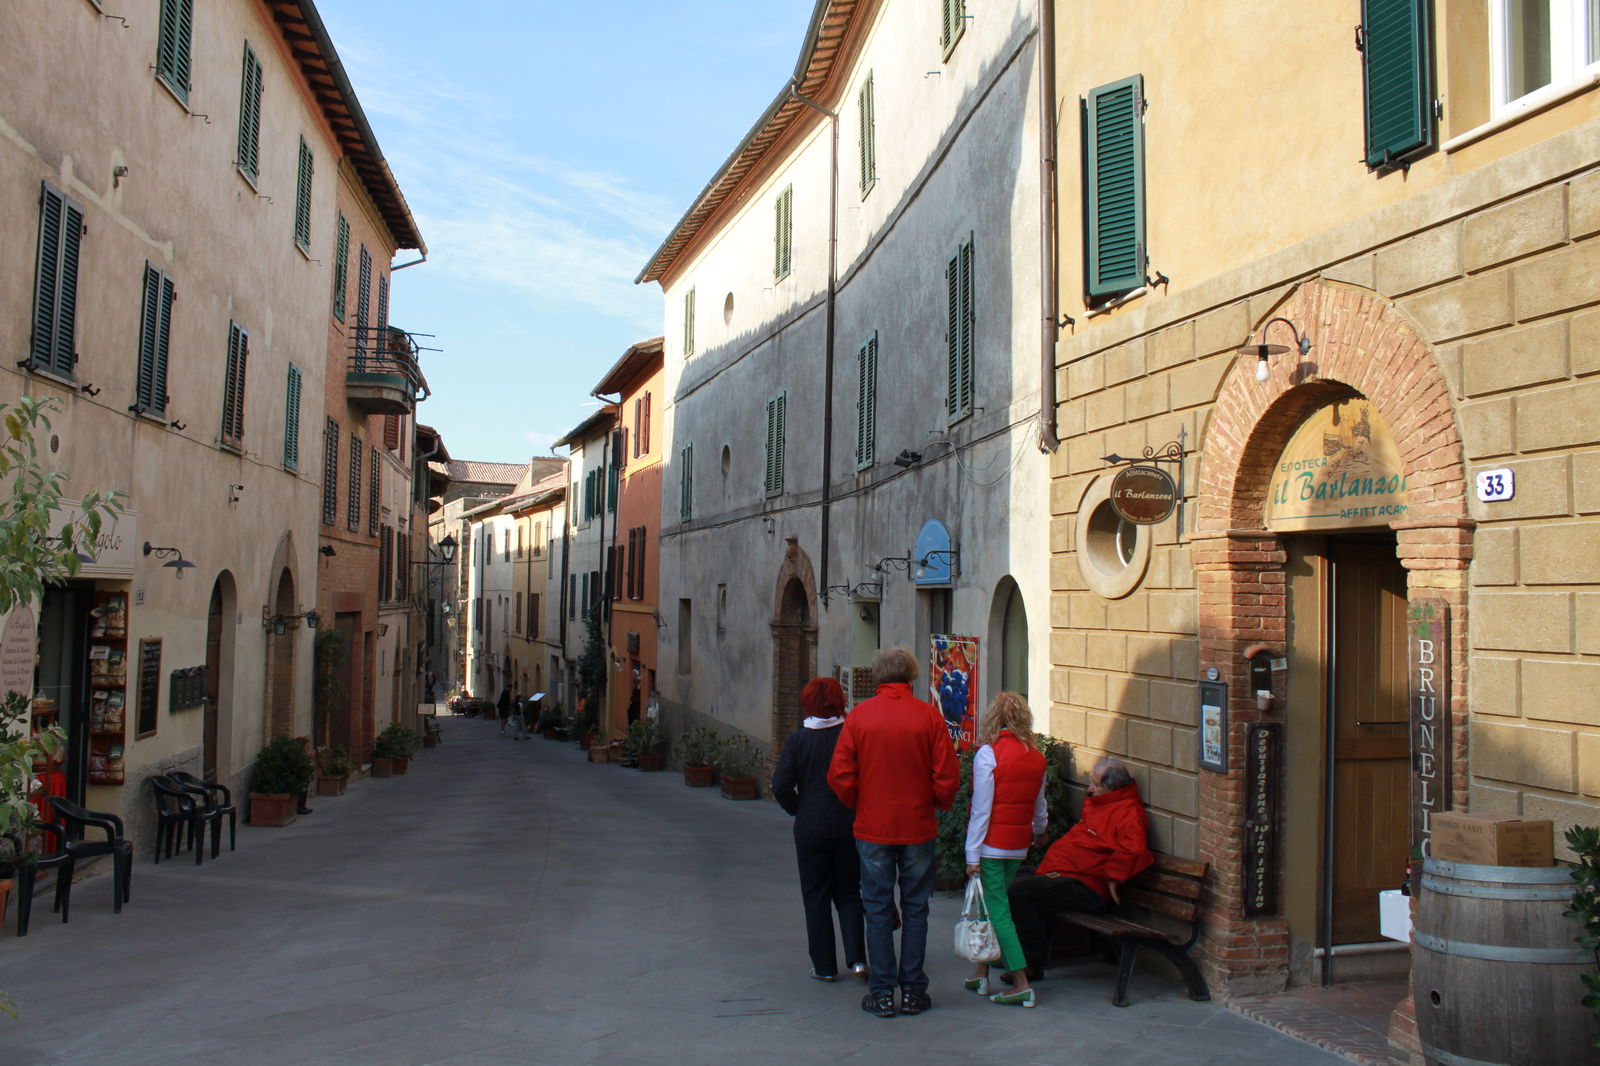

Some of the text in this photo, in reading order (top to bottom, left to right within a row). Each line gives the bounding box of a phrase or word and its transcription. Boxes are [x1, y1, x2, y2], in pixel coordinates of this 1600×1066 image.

[1114, 488, 1172, 500] il Barlanzone
[1273, 480, 1288, 505] il
[1484, 474, 1505, 496] 33
